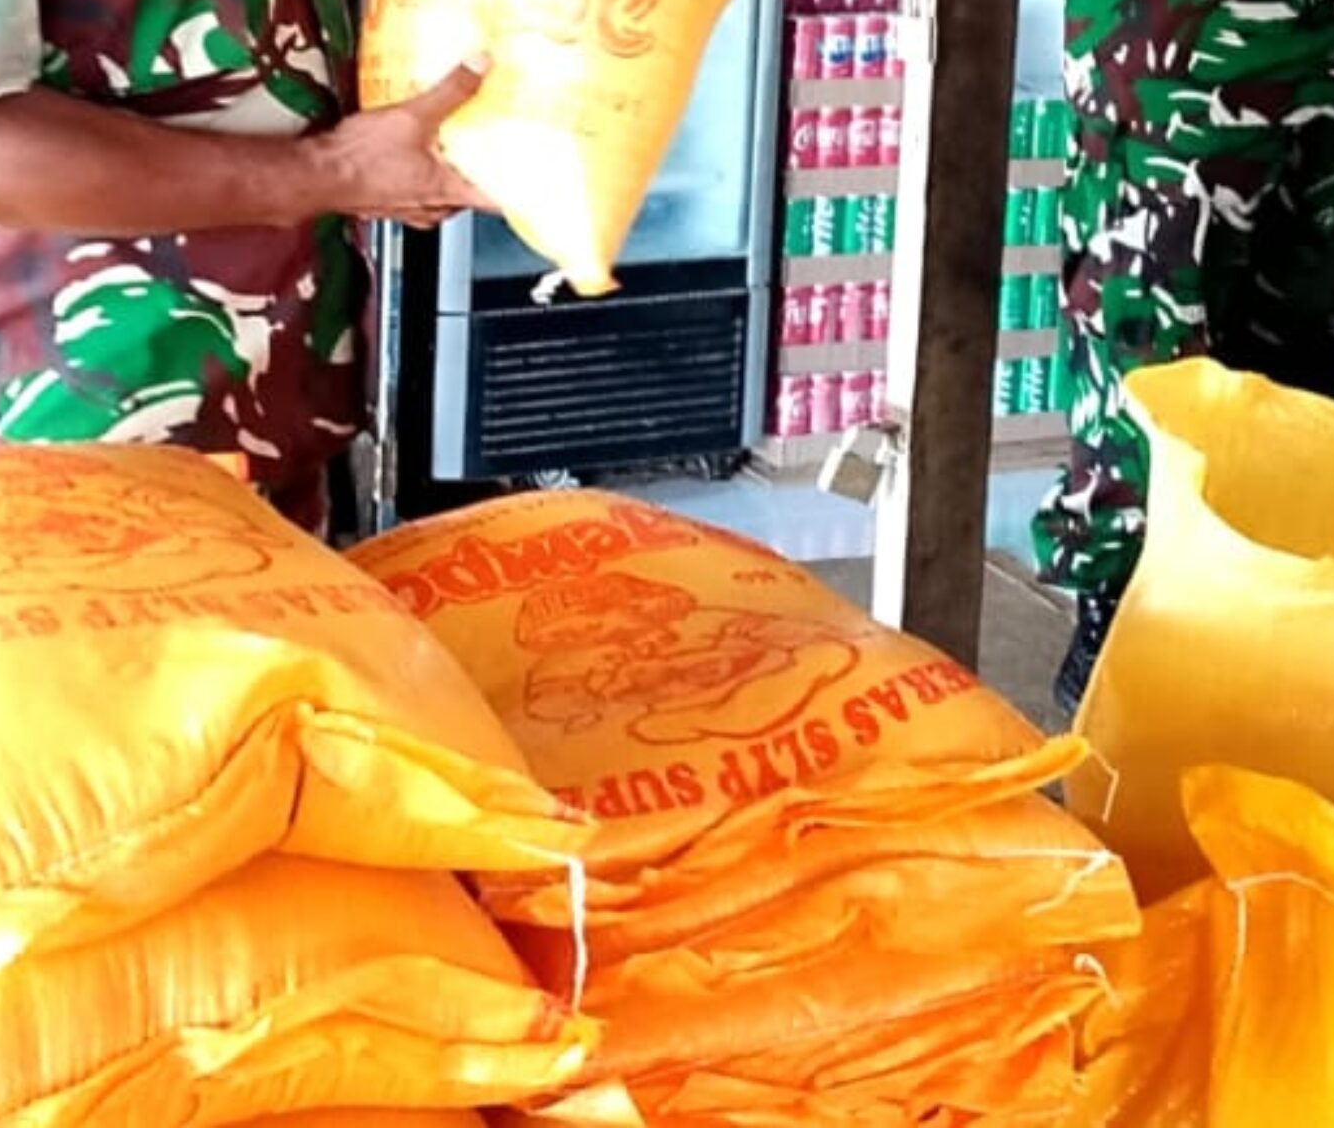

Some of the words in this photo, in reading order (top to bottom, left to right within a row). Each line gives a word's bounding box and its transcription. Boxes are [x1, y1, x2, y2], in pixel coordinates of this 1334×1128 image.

[385, 503, 699, 621] Tempo
[841, 661, 972, 747] ERAS
[549, 761, 705, 819] SUPE
[719, 718, 840, 806] SLYP
